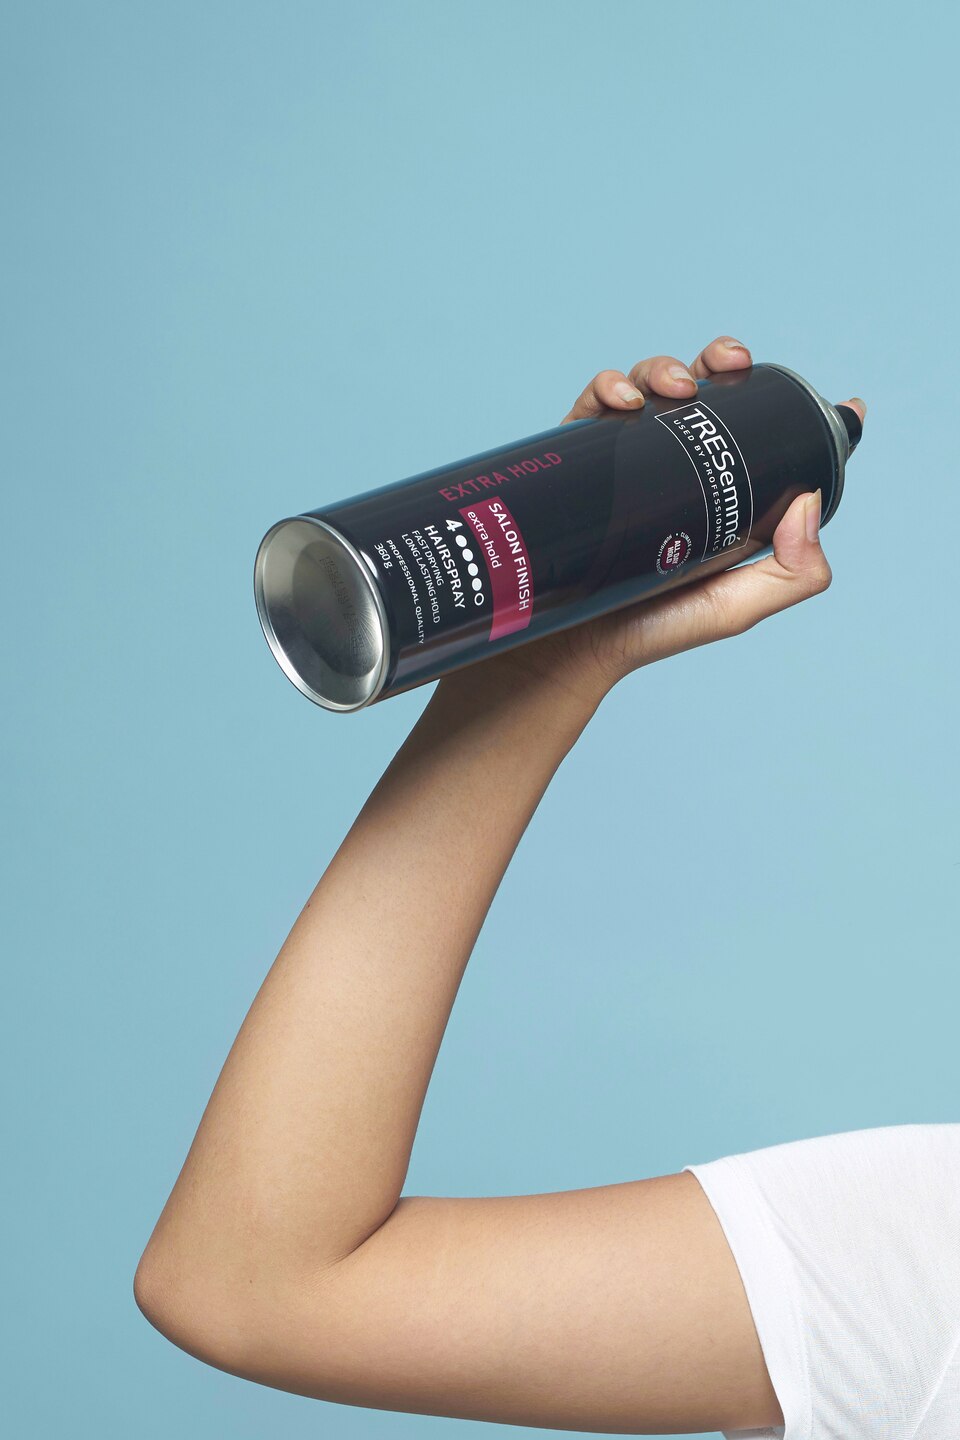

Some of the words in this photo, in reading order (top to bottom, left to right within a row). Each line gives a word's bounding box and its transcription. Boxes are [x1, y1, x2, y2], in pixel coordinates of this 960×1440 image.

[438, 471, 510, 501] EXTRA
[507, 452, 562, 478] HOLD
[673, 419, 695, 441] USED
[694, 444, 705, 457] BY
[702, 461, 722, 552] PROFESSIONALS
[682, 407, 741, 547] TRESemmé
[373, 542, 391, 561] 360
[383, 561, 393, 569] g
[411, 530, 430, 550] FAST
[424, 550, 445, 586] DRYING
[424, 524, 466, 609] HAIRSPRAY
[445, 519, 464, 532] 4
[467, 511, 489, 541] extra
[484, 540, 502, 569] hold
[488, 502, 523, 555] SALON
[514, 556, 531, 612] FINISH
[386, 539, 420, 605] PROFESSIONAL
[415, 605, 425, 644] QUALITY
[401, 533, 421, 557] LONG
[416, 557, 437, 597] LASTING
[430, 597, 441, 624] HOLD
